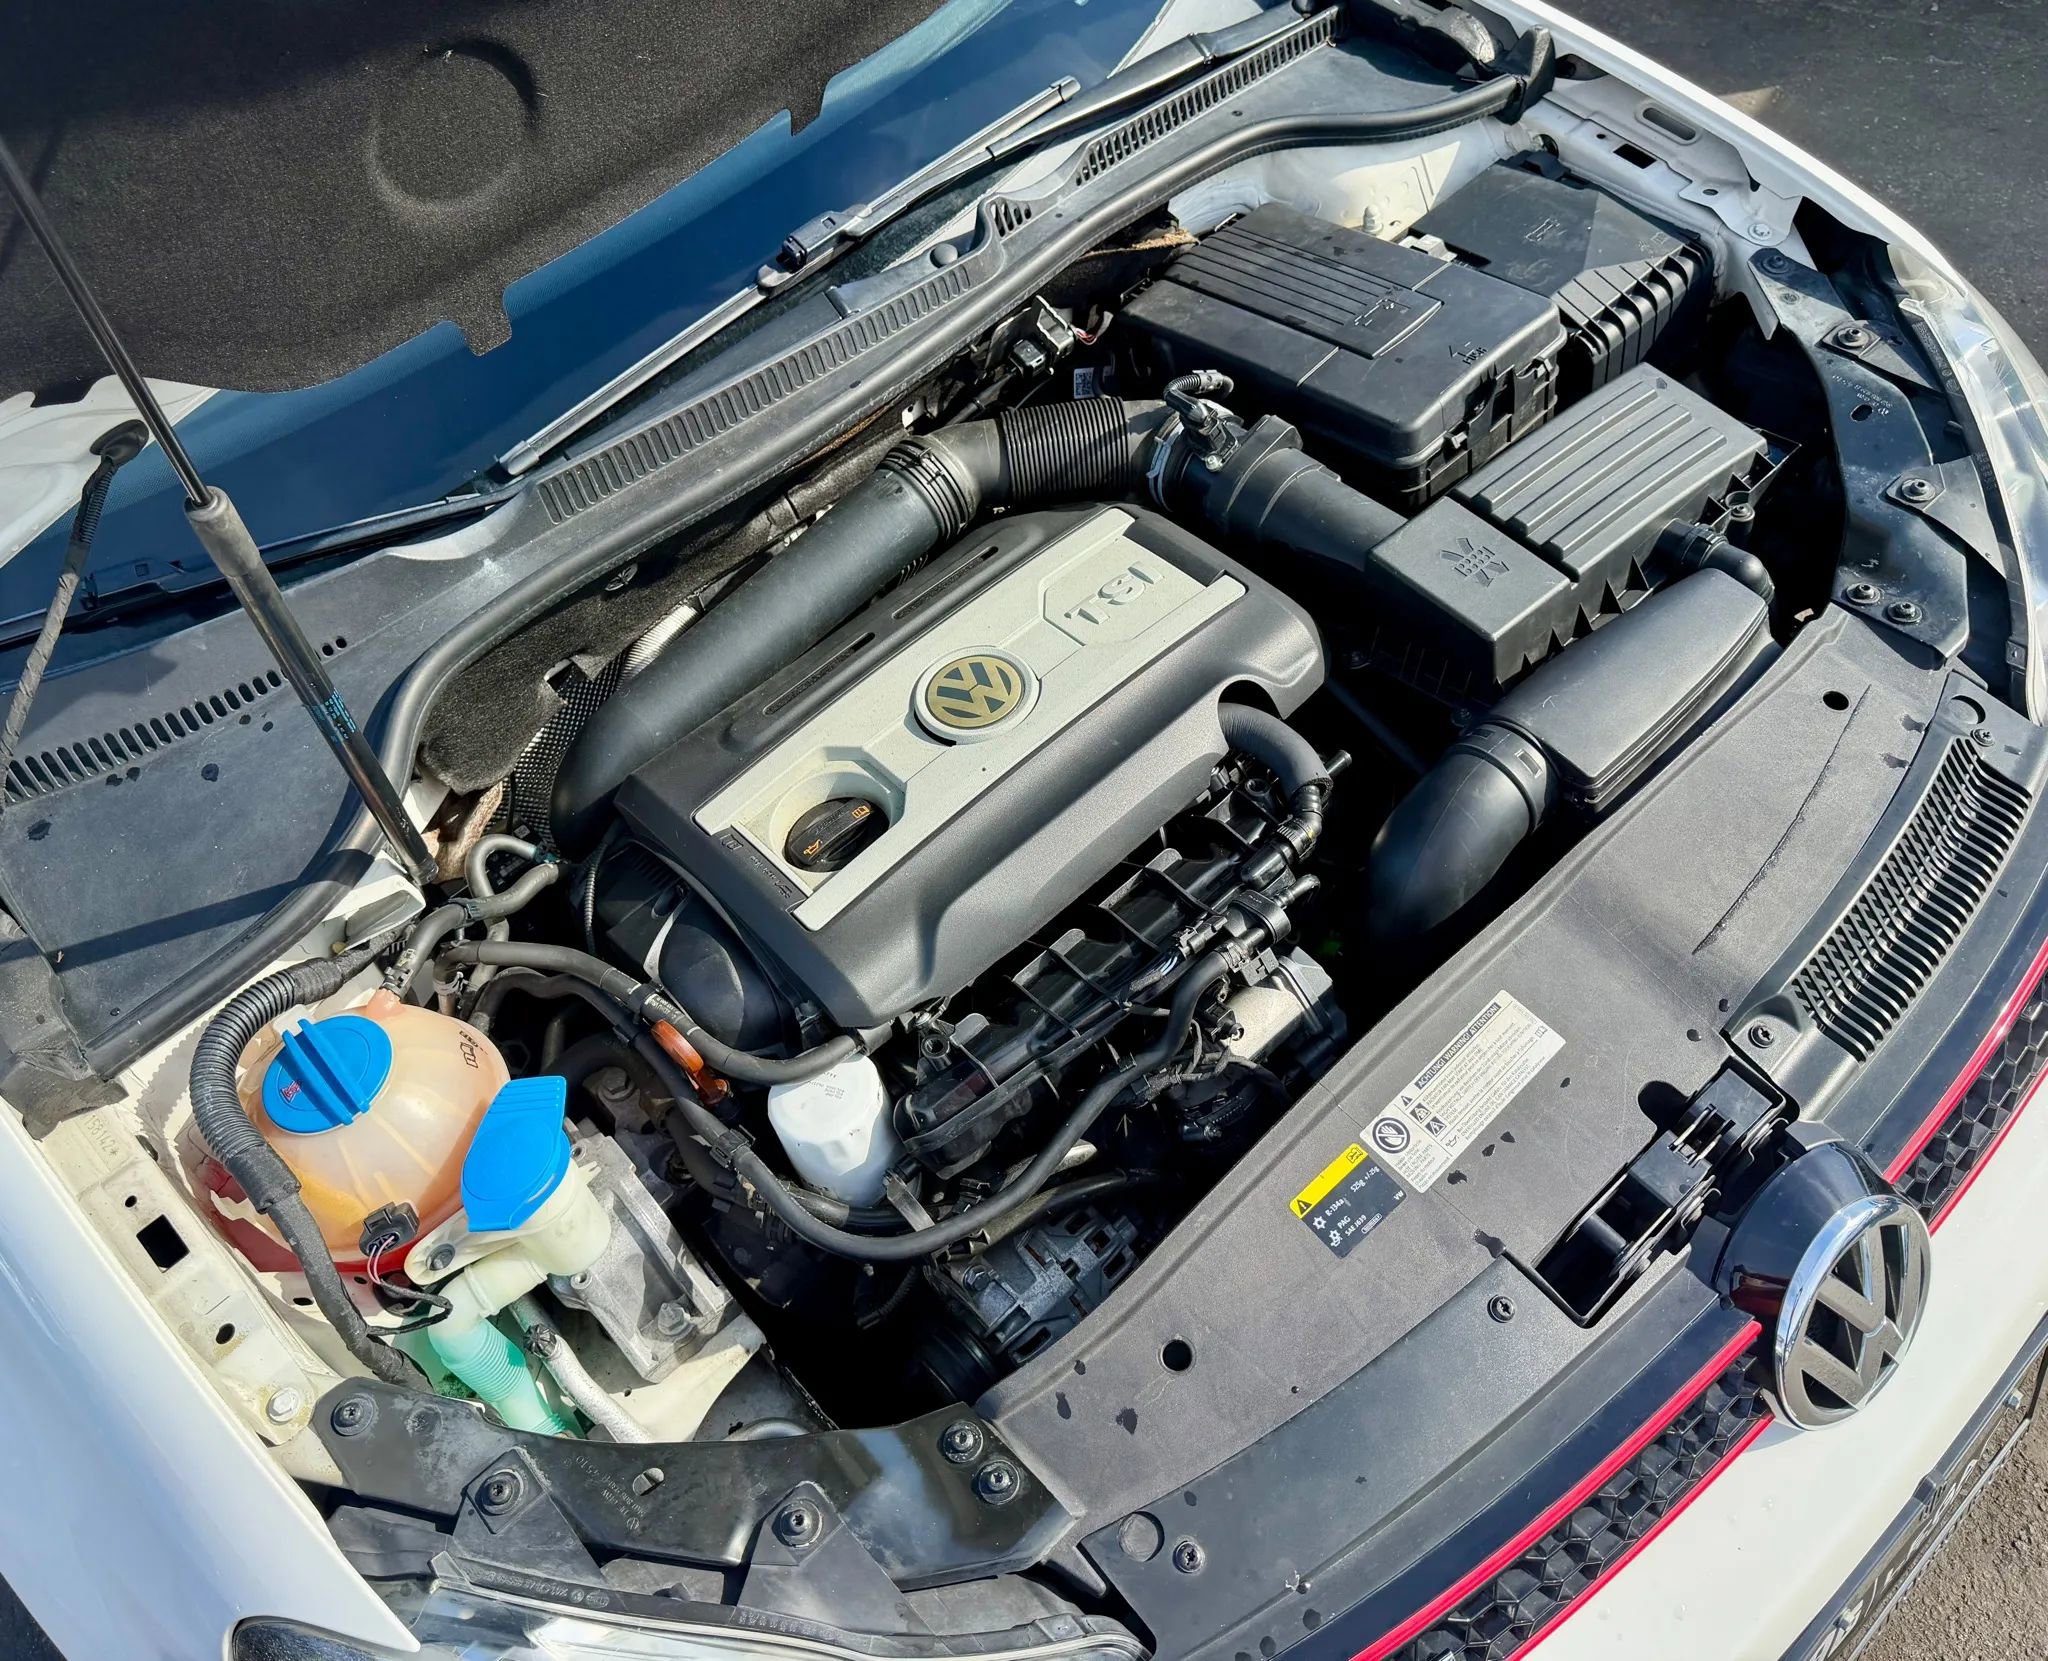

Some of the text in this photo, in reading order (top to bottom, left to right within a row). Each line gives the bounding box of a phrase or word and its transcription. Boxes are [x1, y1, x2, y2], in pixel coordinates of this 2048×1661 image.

[1064, 561, 1165, 625] TSI
[1417, 1059, 1446, 1088] ACHTUNG!
[1442, 1031, 1471, 1061] WARNING!
[1468, 1003, 1499, 1035] ATTENTION!
[1393, 1189, 1405, 1201] VW
[1324, 1197, 1345, 1217] R-134a
[1336, 1214, 1351, 1229] PAG
[1344, 1224, 1356, 1236] SAE
